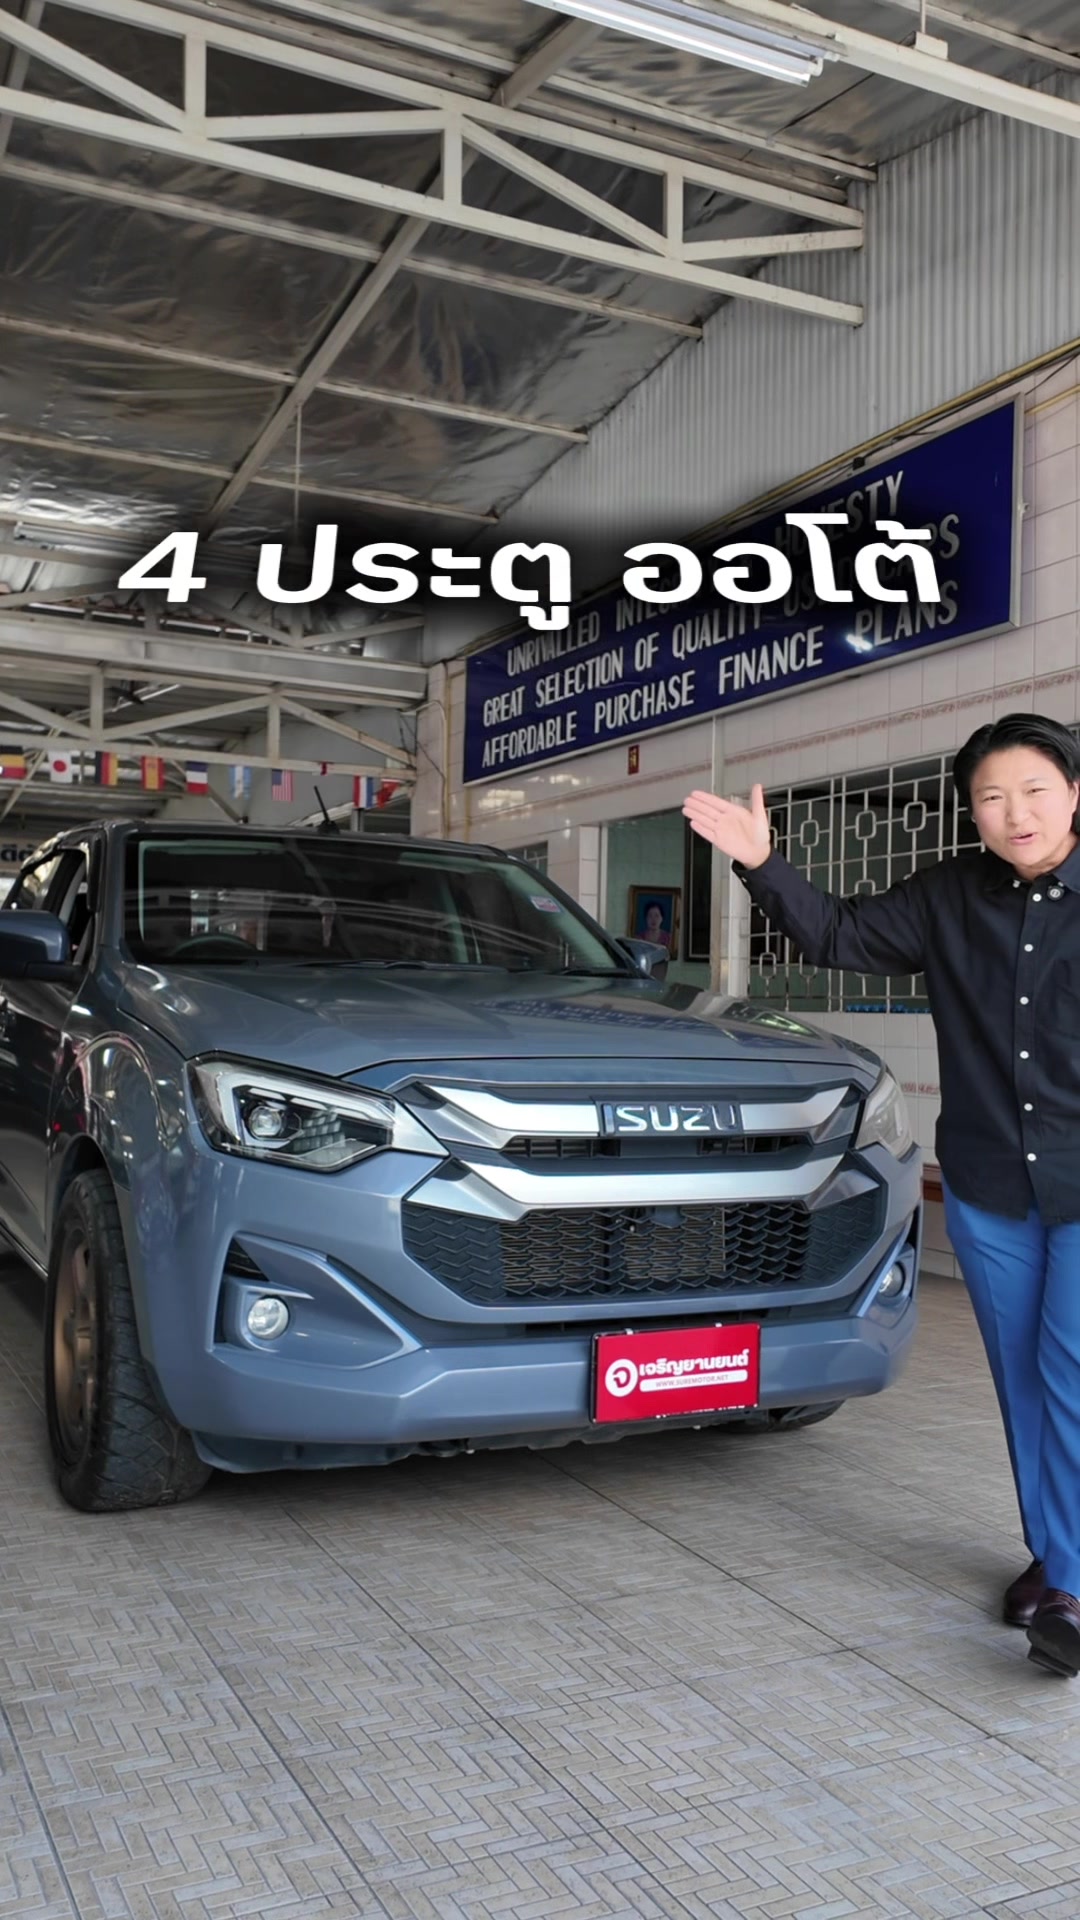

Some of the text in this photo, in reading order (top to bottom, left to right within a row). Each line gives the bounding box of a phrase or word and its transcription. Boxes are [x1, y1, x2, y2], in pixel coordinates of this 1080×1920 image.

[482, 580, 958, 768] AFFORDABLE PURCHASE FINANCE PLANS
[483, 686, 526, 727] GREAT
[535, 647, 623, 708] SELECTION
[634, 632, 660, 671] OF
[672, 596, 766, 660] QUALITY
[507, 611, 600, 676] UNRIVALLED
[603, 1103, 735, 1135] ISUZU
[639, 1348, 749, 1376] เจริญยานยนต์
